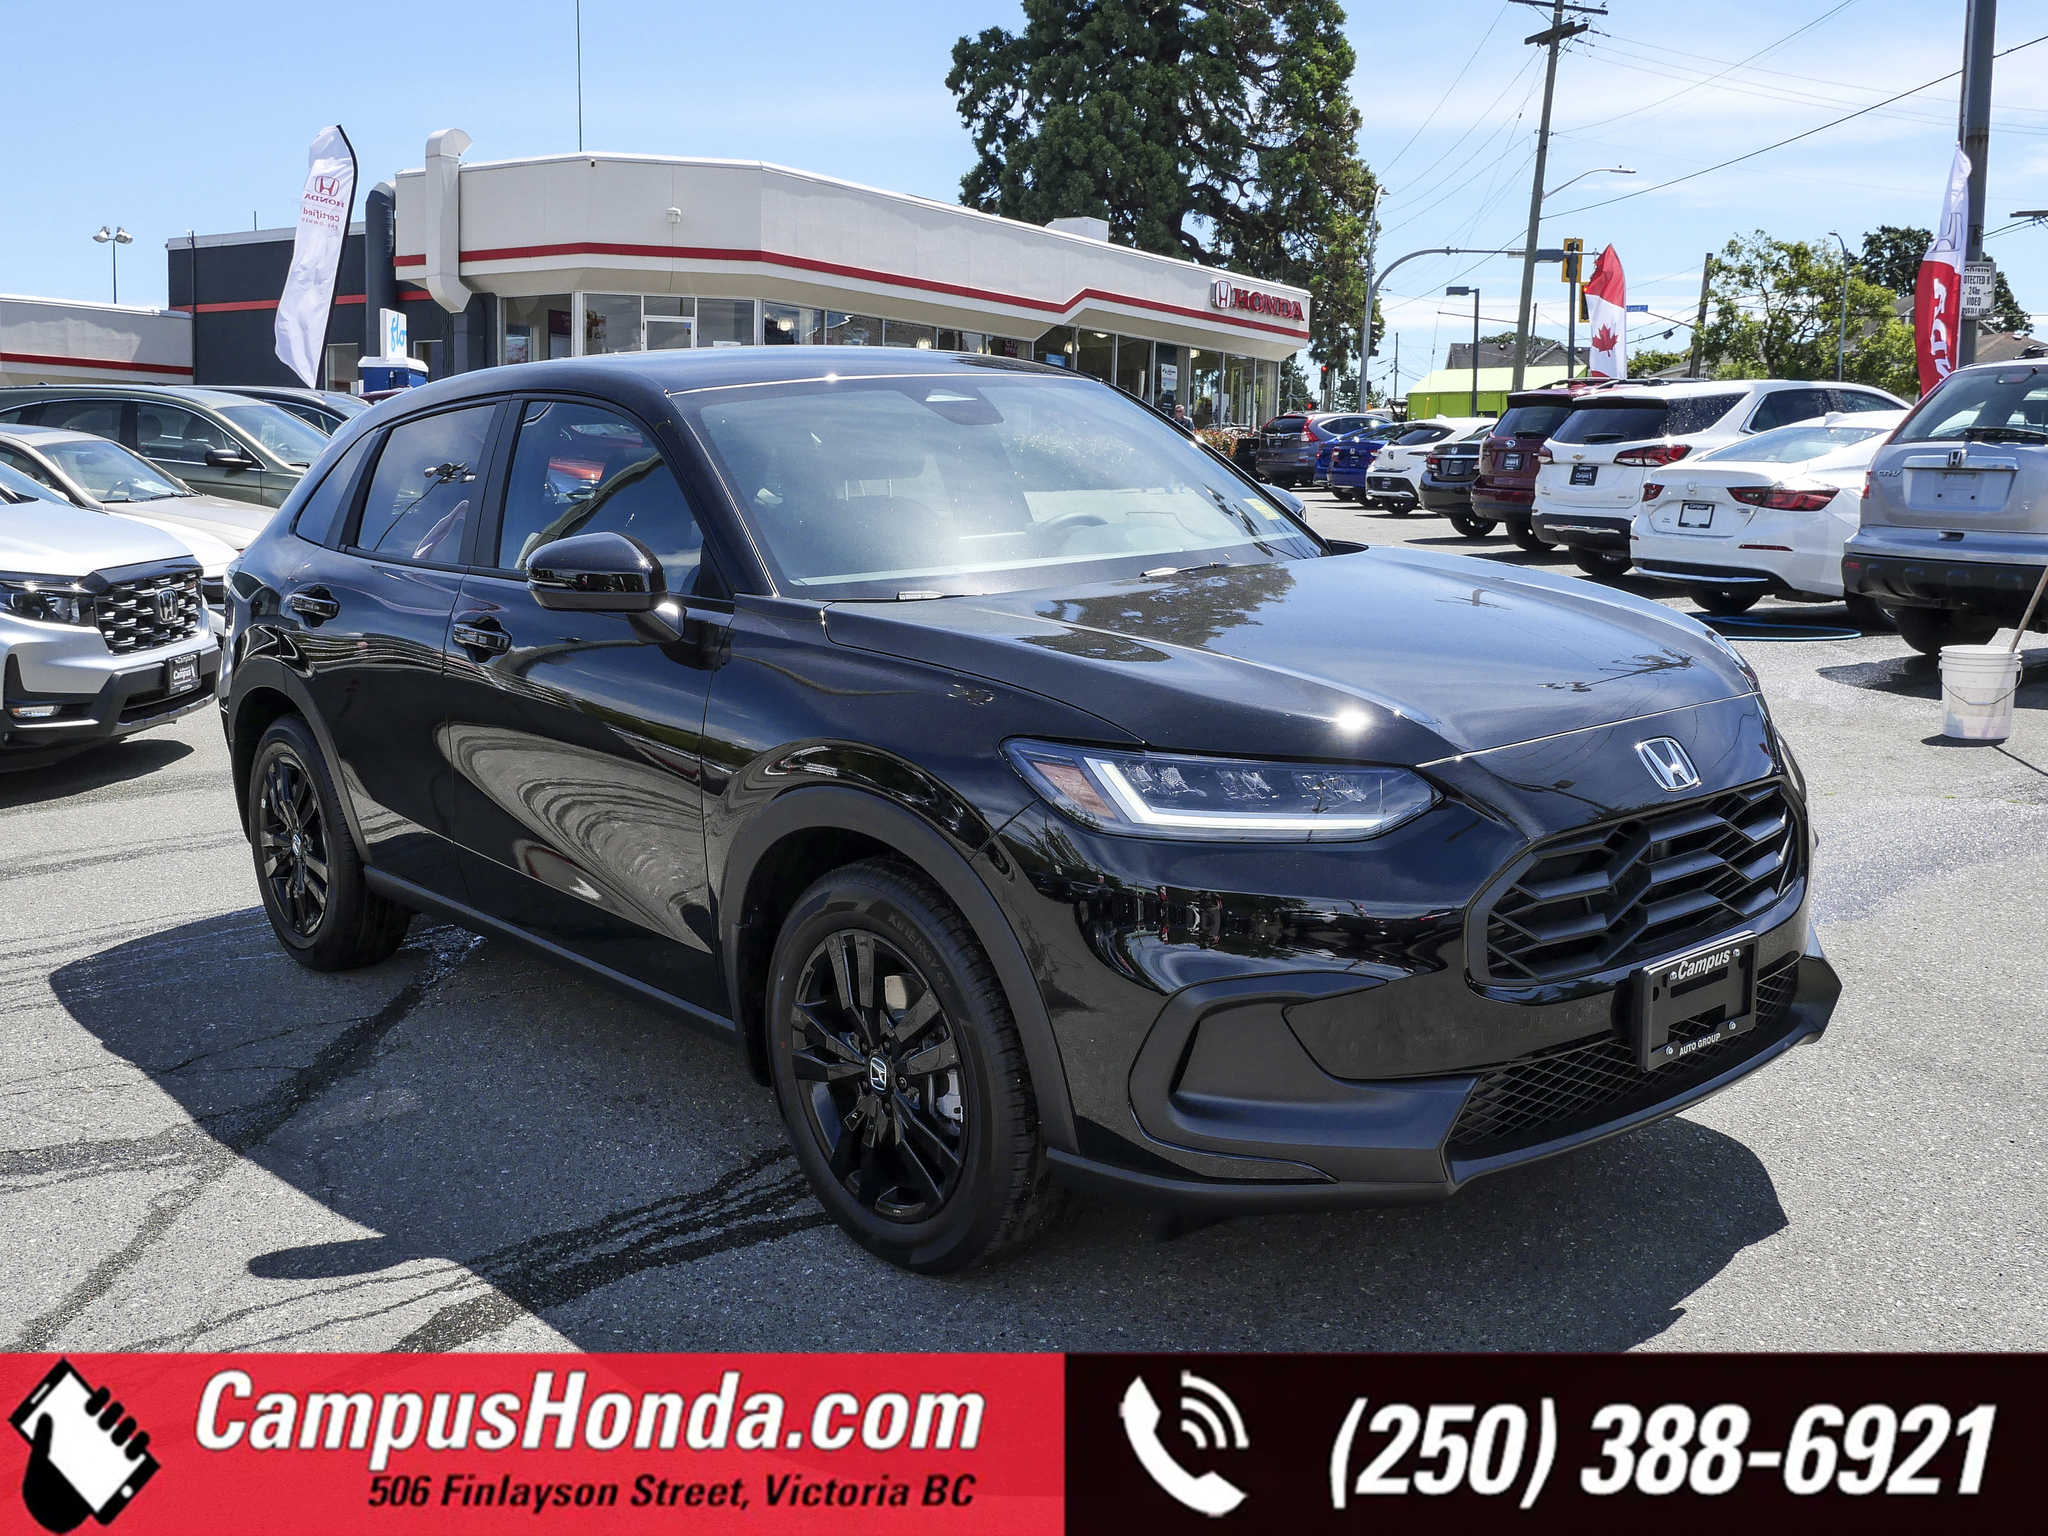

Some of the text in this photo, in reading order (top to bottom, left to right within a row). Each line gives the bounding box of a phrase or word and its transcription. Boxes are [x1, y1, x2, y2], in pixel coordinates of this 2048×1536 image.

[1963, 275, 1985, 285] OTECTED
[1233, 288, 1305, 321] HONDA
[1966, 297, 1982, 306] VIDEO
[390, 313, 407, 352] flo
[1877, 469, 1901, 477] CR-V
[1678, 950, 1730, 980] Campus
[1679, 1033, 1721, 1056] AUTO GROUP
